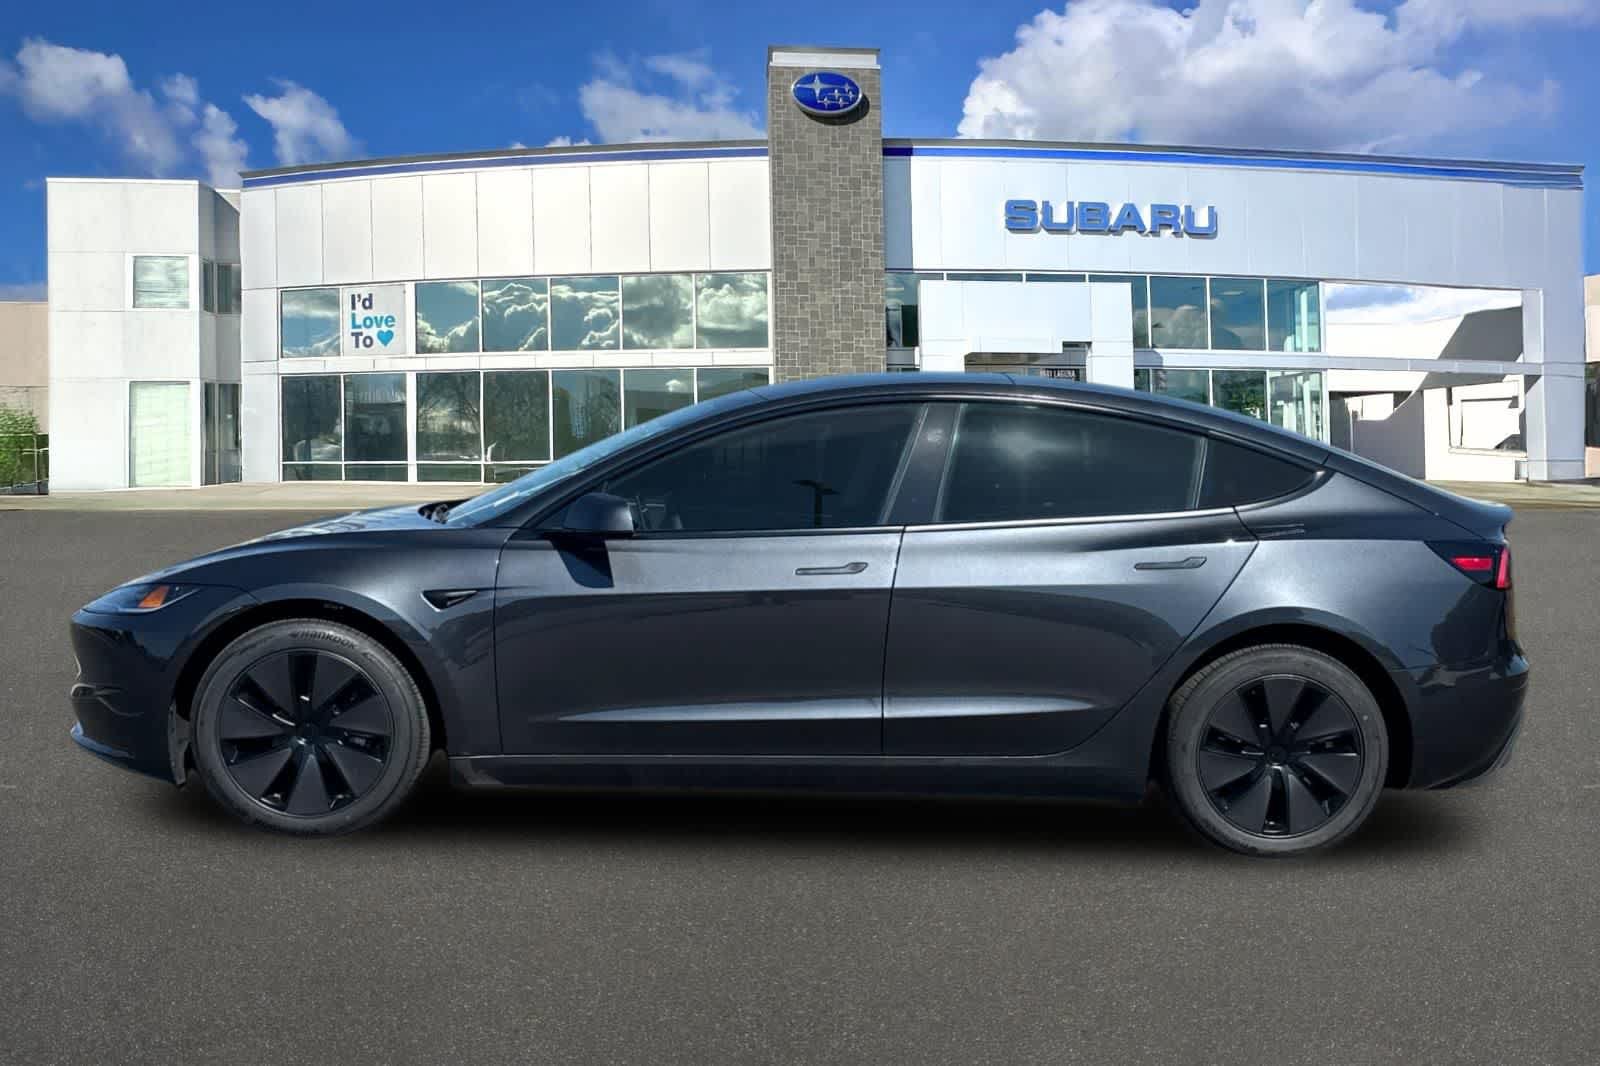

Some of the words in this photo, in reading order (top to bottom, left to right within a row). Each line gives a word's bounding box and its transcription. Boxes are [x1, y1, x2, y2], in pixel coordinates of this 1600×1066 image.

[1005, 200, 1217, 237] SUBARU
[351, 293, 373, 310] I'd
[351, 313, 395, 329] Love
[351, 332, 373, 348] To
